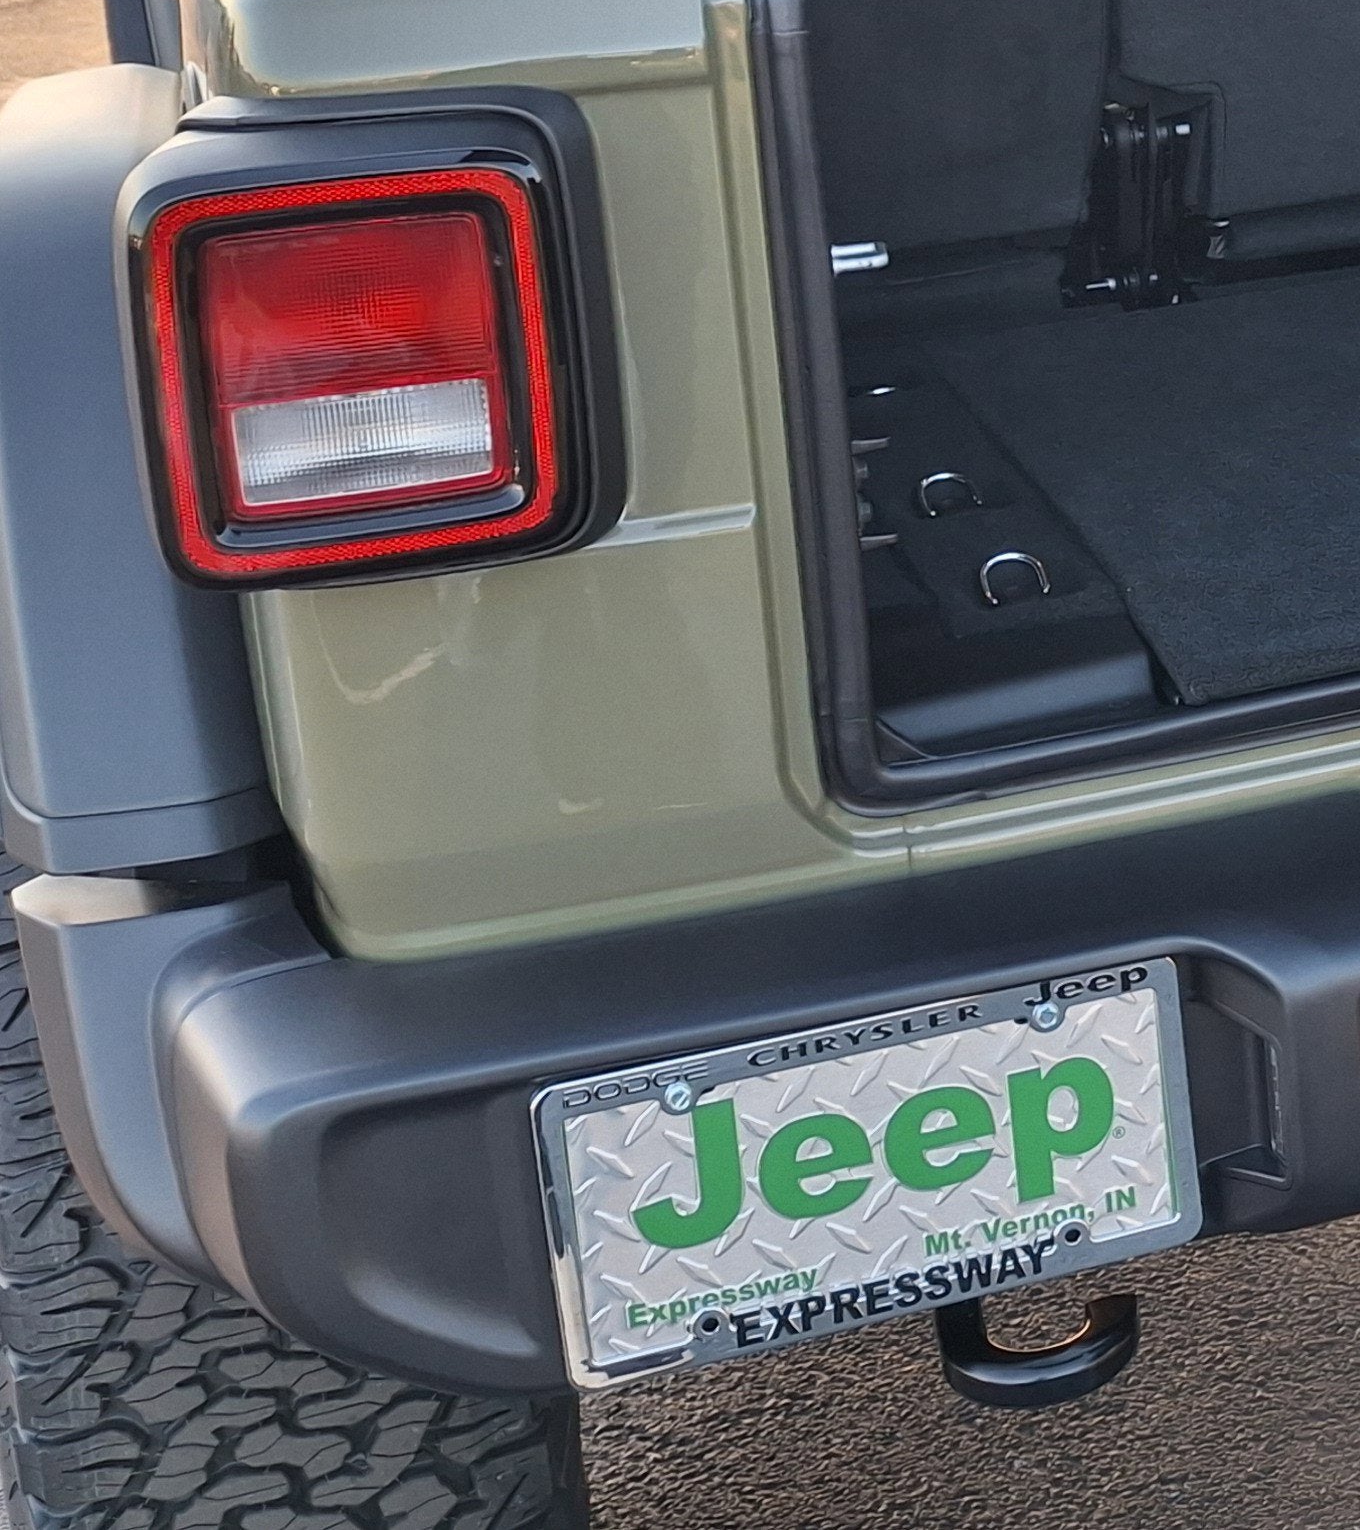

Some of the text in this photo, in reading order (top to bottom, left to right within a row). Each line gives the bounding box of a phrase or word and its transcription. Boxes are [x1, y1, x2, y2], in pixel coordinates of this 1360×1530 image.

[562, 966, 1148, 1109] DODGE CHRYSLER Jeep
[630, 1056, 1115, 1249] Jeep
[924, 1186, 1138, 1257] Mt. Vernon, IN
[628, 1269, 818, 1329] Expressway
[729, 1231, 1055, 1349] EXPRESSWAY
